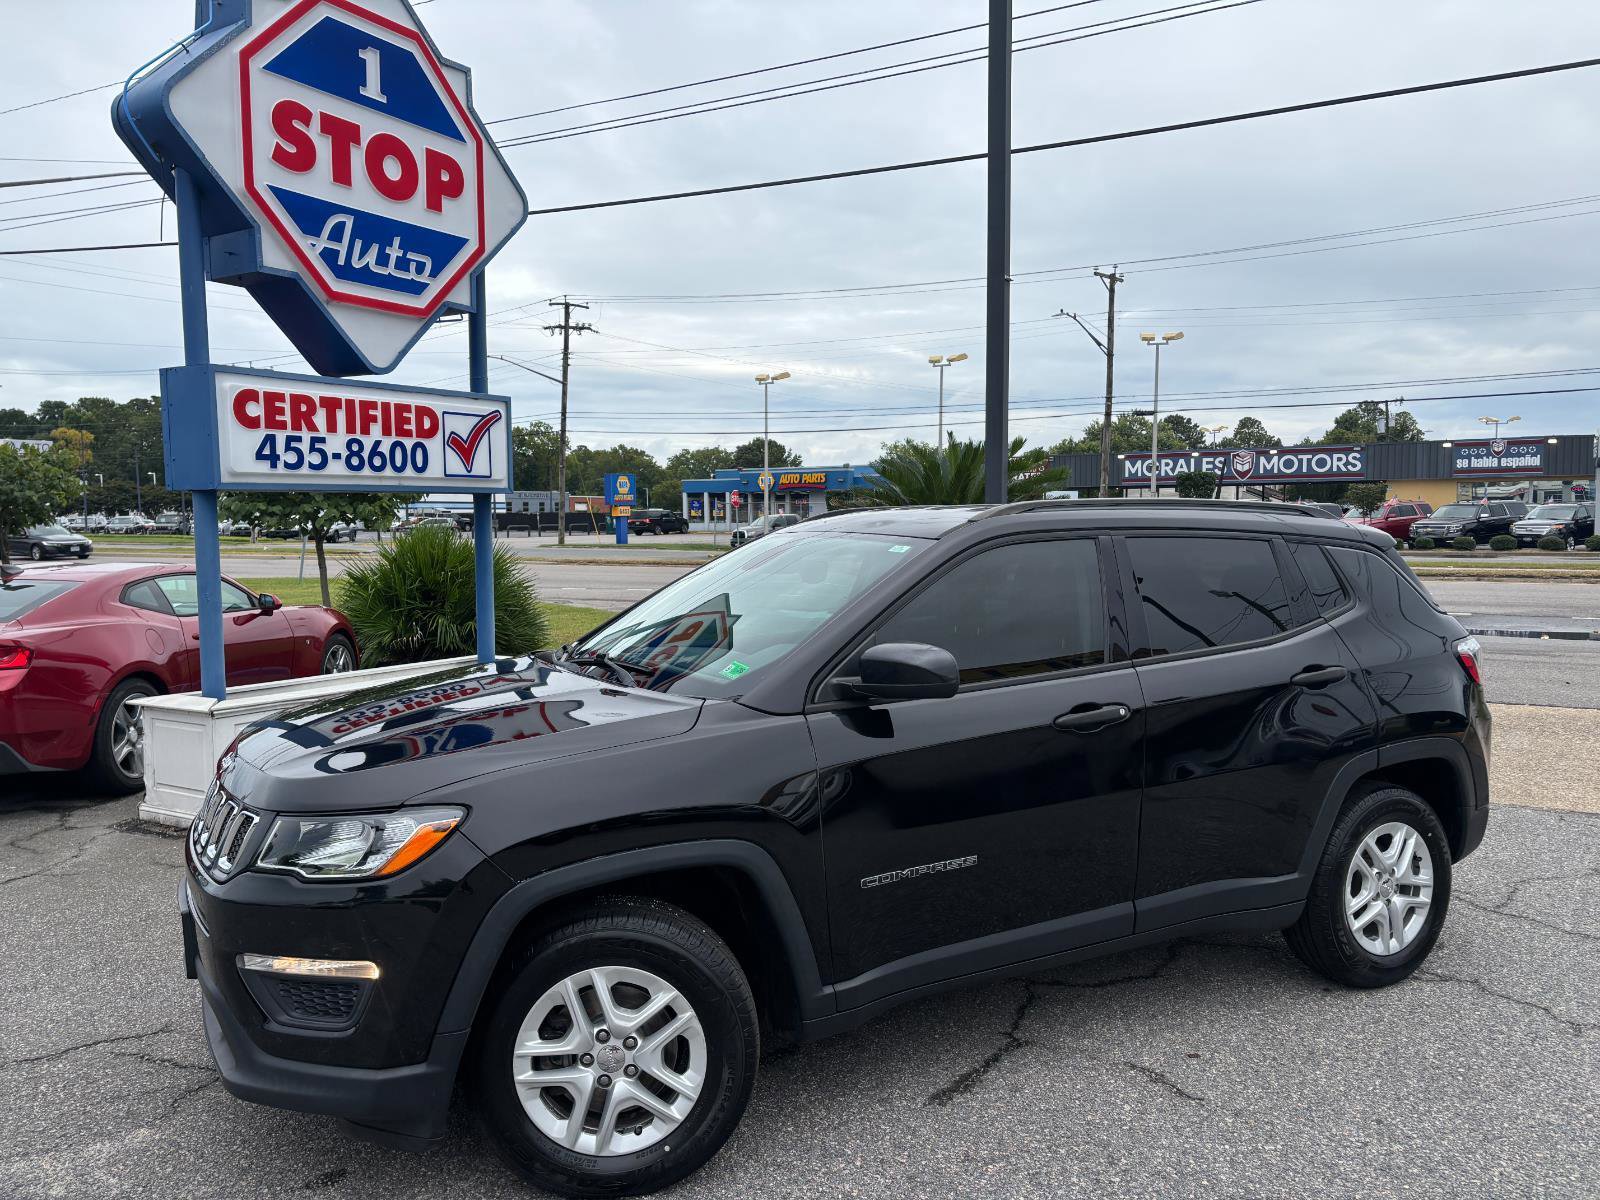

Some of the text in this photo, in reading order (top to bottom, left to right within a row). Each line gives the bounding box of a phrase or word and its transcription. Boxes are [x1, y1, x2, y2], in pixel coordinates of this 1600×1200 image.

[358, 46, 388, 104] 1
[271, 99, 465, 213] STOP
[307, 213, 437, 283] Auto
[232, 388, 440, 440] CERTIFIED
[255, 432, 429, 475] 455-8600
[1124, 452, 1362, 478] MORALES MOTORS
[1456, 454, 1541, 469] se habla español
[779, 473, 800, 485] AUTO
[802, 472, 826, 484] PARTS
[861, 855, 978, 889] COMPASS
